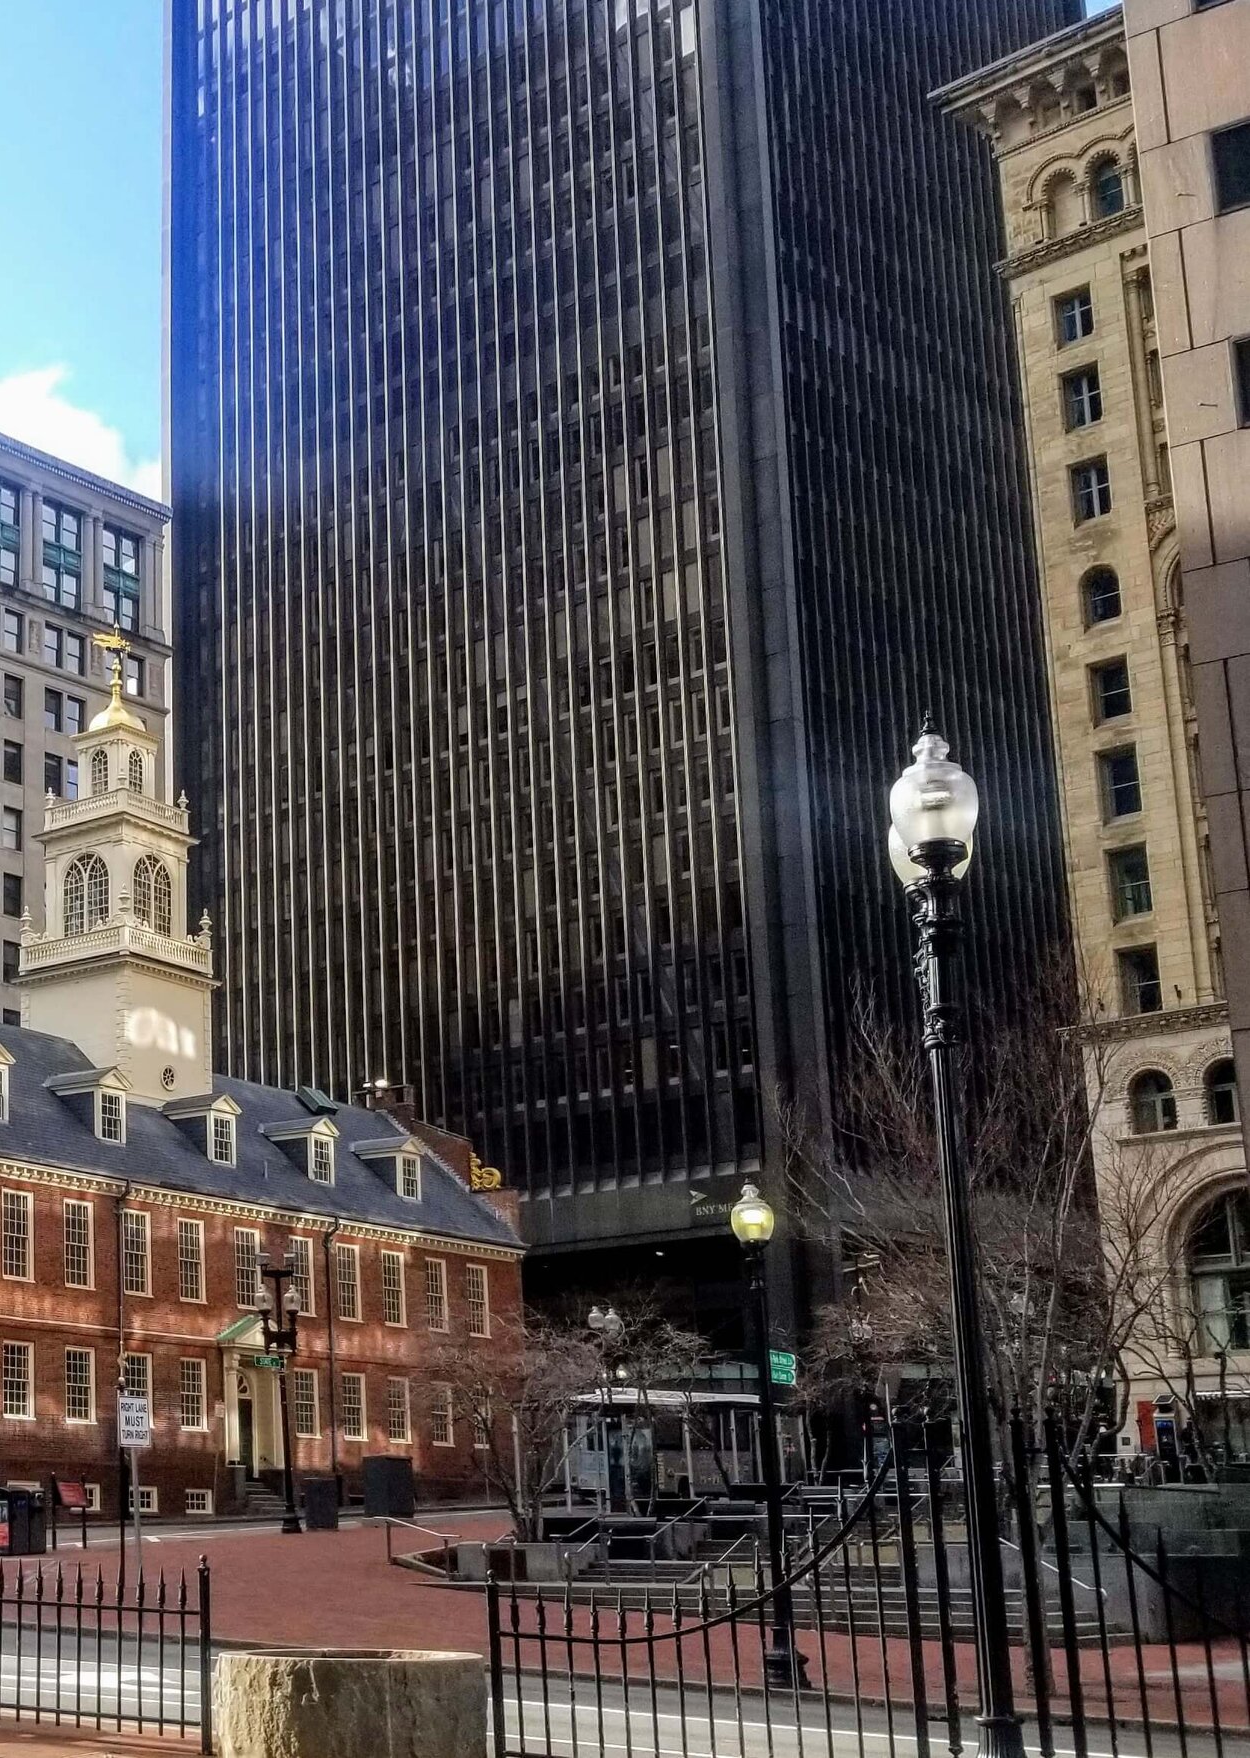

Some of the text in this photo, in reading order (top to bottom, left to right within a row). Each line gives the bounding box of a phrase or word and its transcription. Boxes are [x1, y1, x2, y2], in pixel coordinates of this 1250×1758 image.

[696, 1203, 733, 1216] BNY ME
[121, 1402, 147, 1413] RIGHT LANE
[125, 1415, 143, 1426] MUST
[122, 1429, 147, 1439] TURN RIGHT
